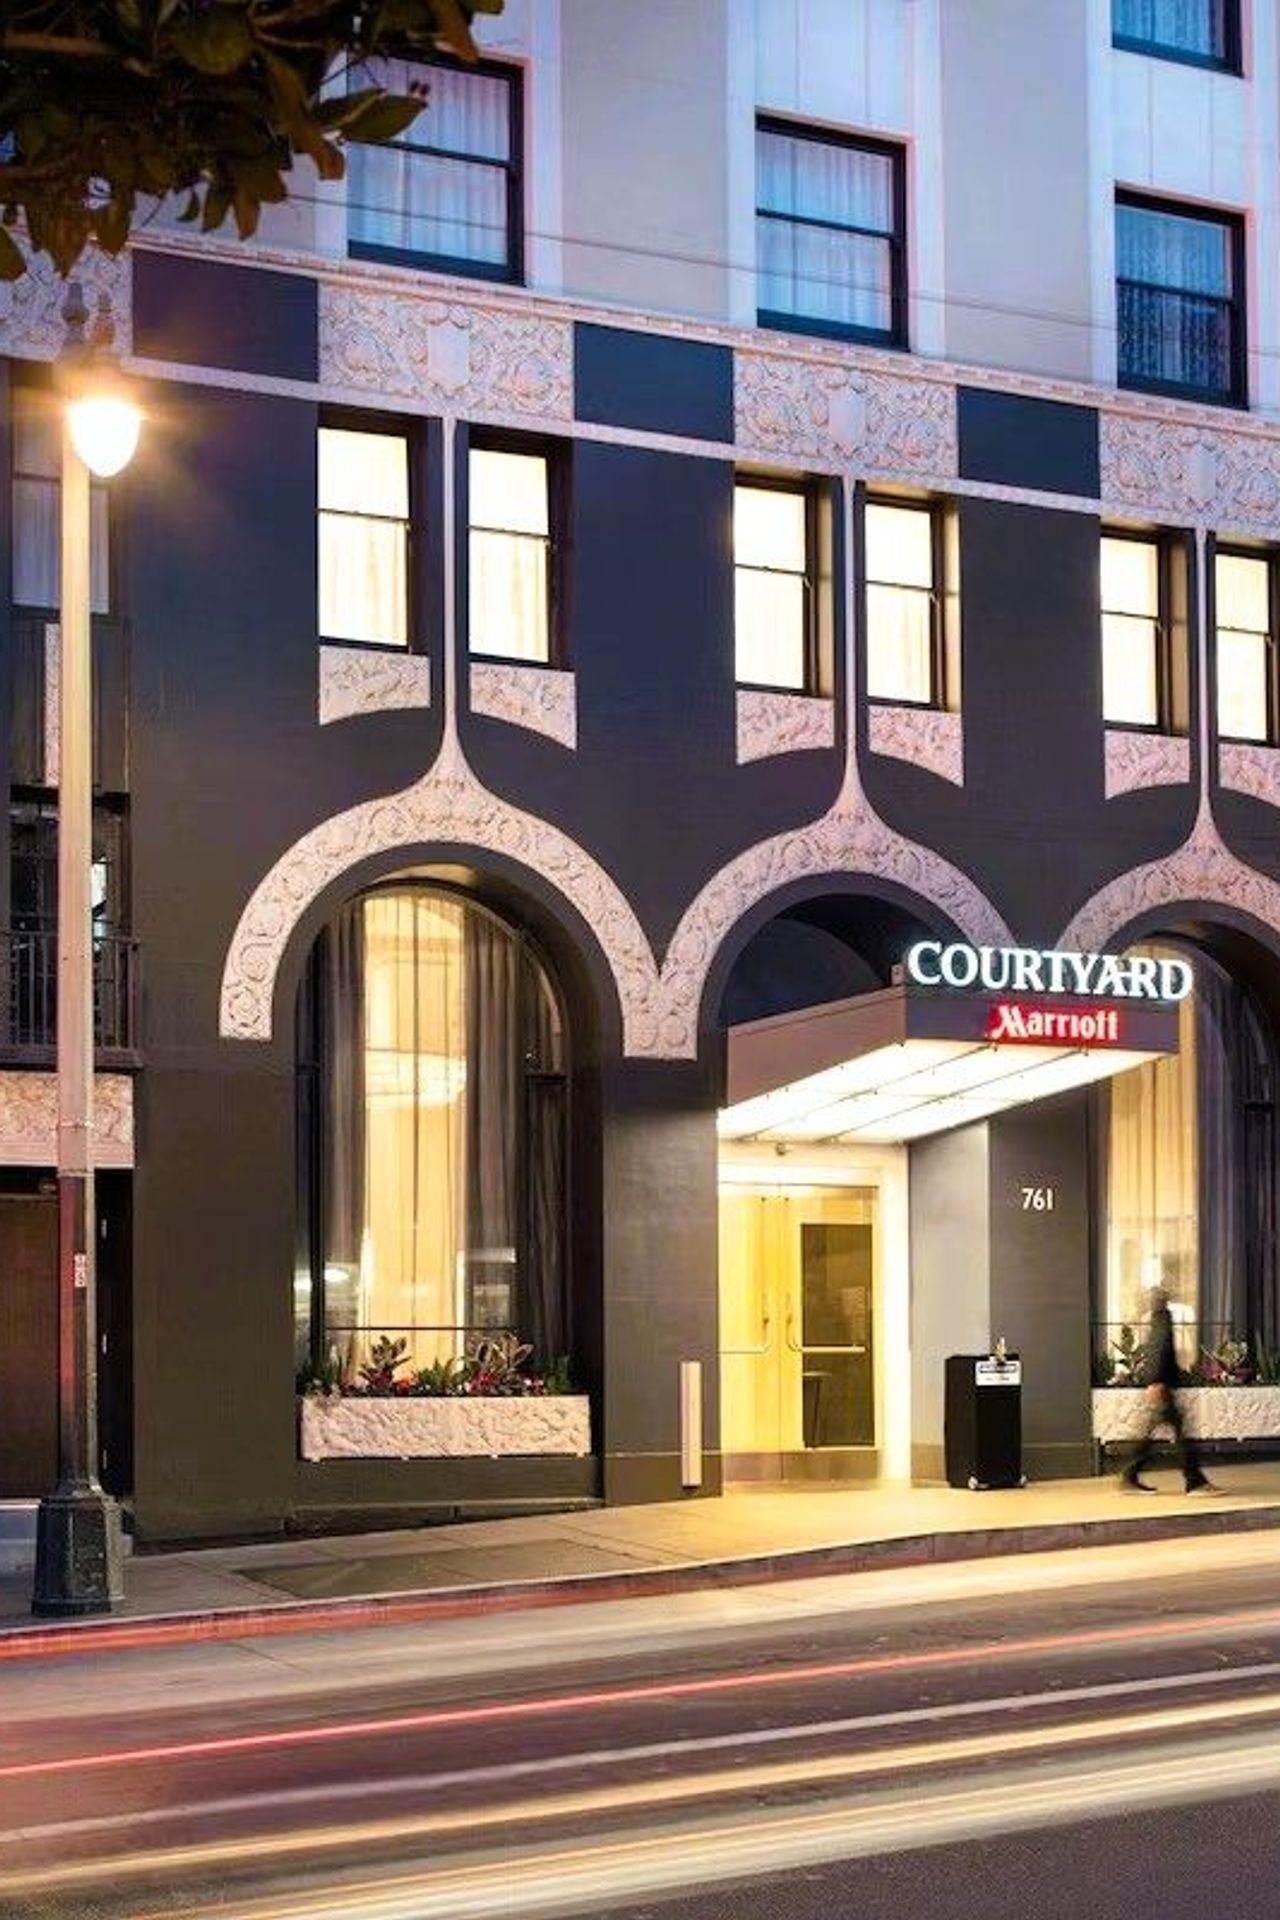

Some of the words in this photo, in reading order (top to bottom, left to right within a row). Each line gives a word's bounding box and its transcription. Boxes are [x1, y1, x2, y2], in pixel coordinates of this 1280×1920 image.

[908, 941, 1193, 1000] COURTYARD
[988, 1004, 1119, 1040] Marriott
[1021, 1187, 1053, 1210] 761
